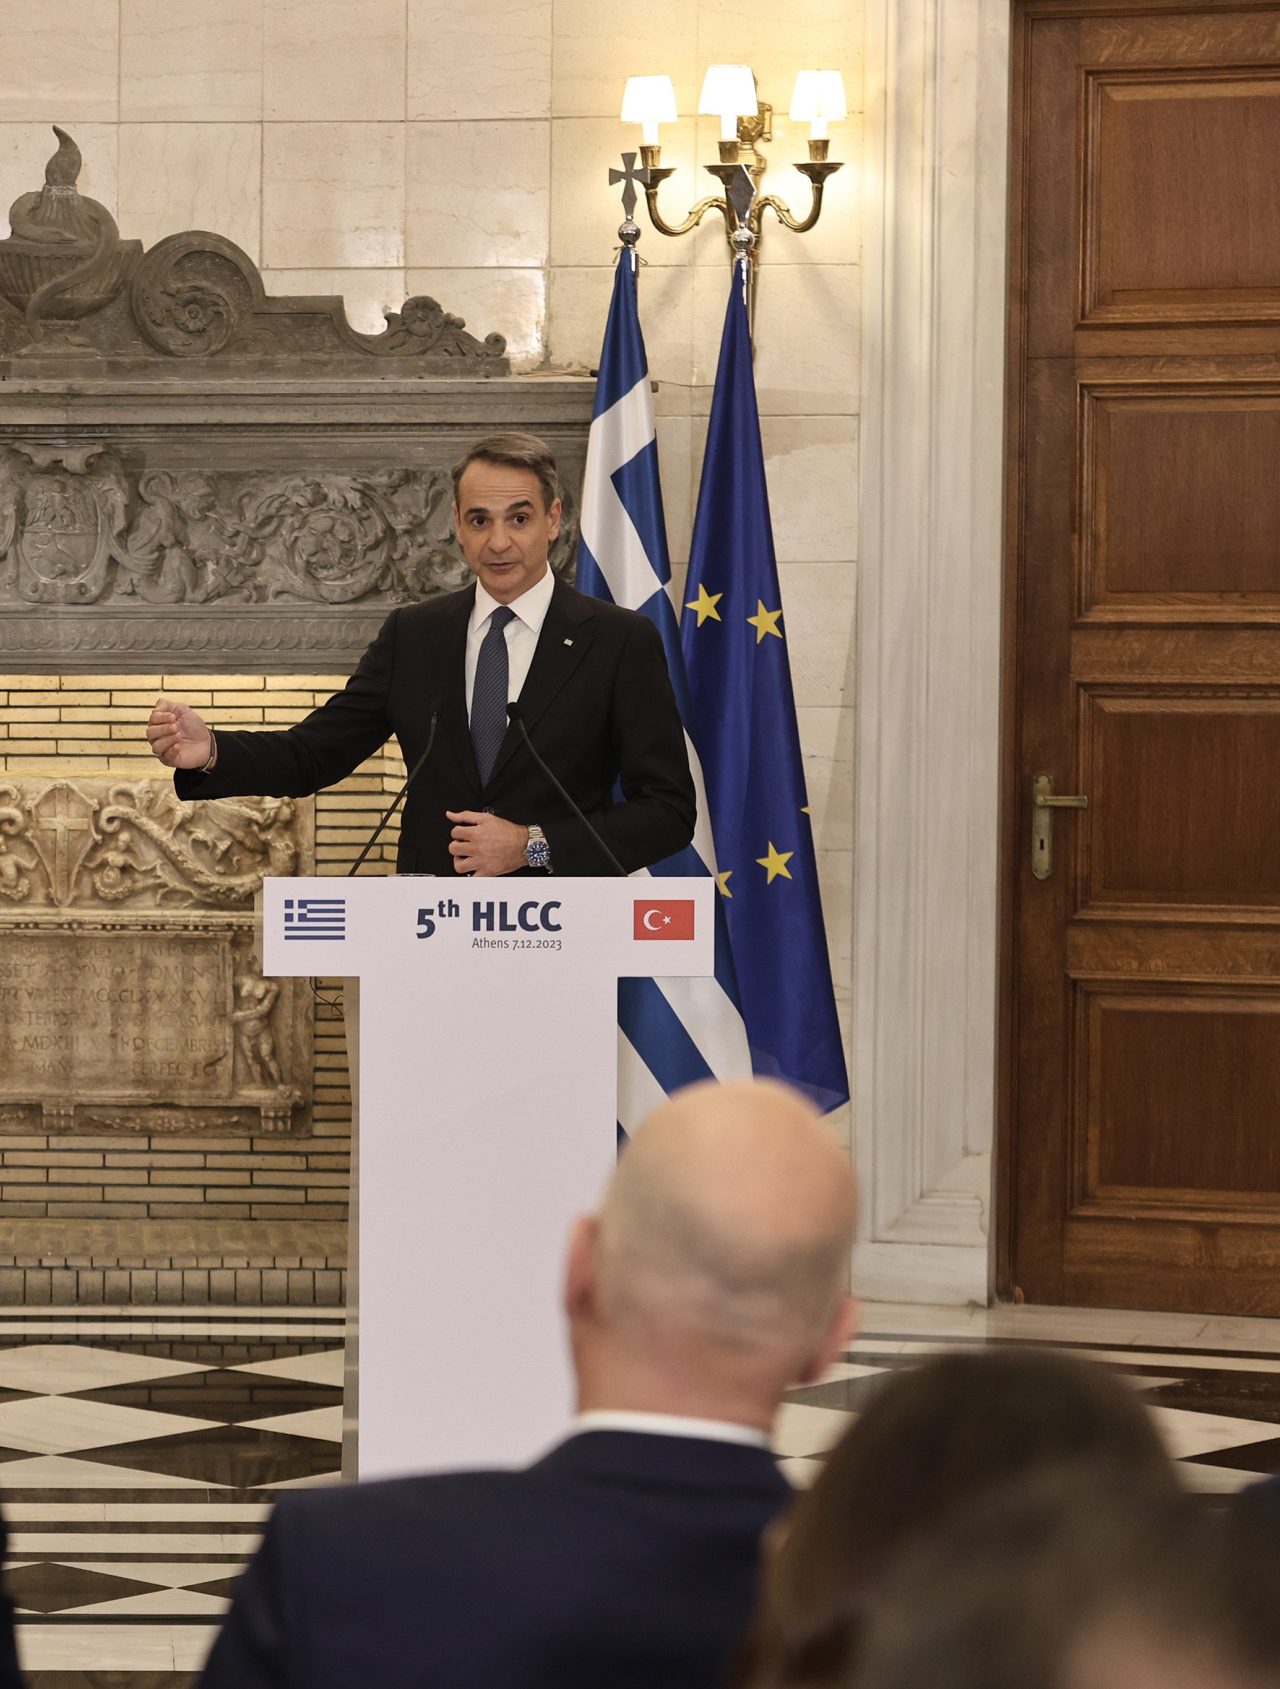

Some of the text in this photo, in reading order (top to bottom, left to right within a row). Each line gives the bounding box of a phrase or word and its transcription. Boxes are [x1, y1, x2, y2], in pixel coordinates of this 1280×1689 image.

[416, 899, 562, 939] 5th HLCC
[472, 937, 563, 952] Athens 7.12.2023
